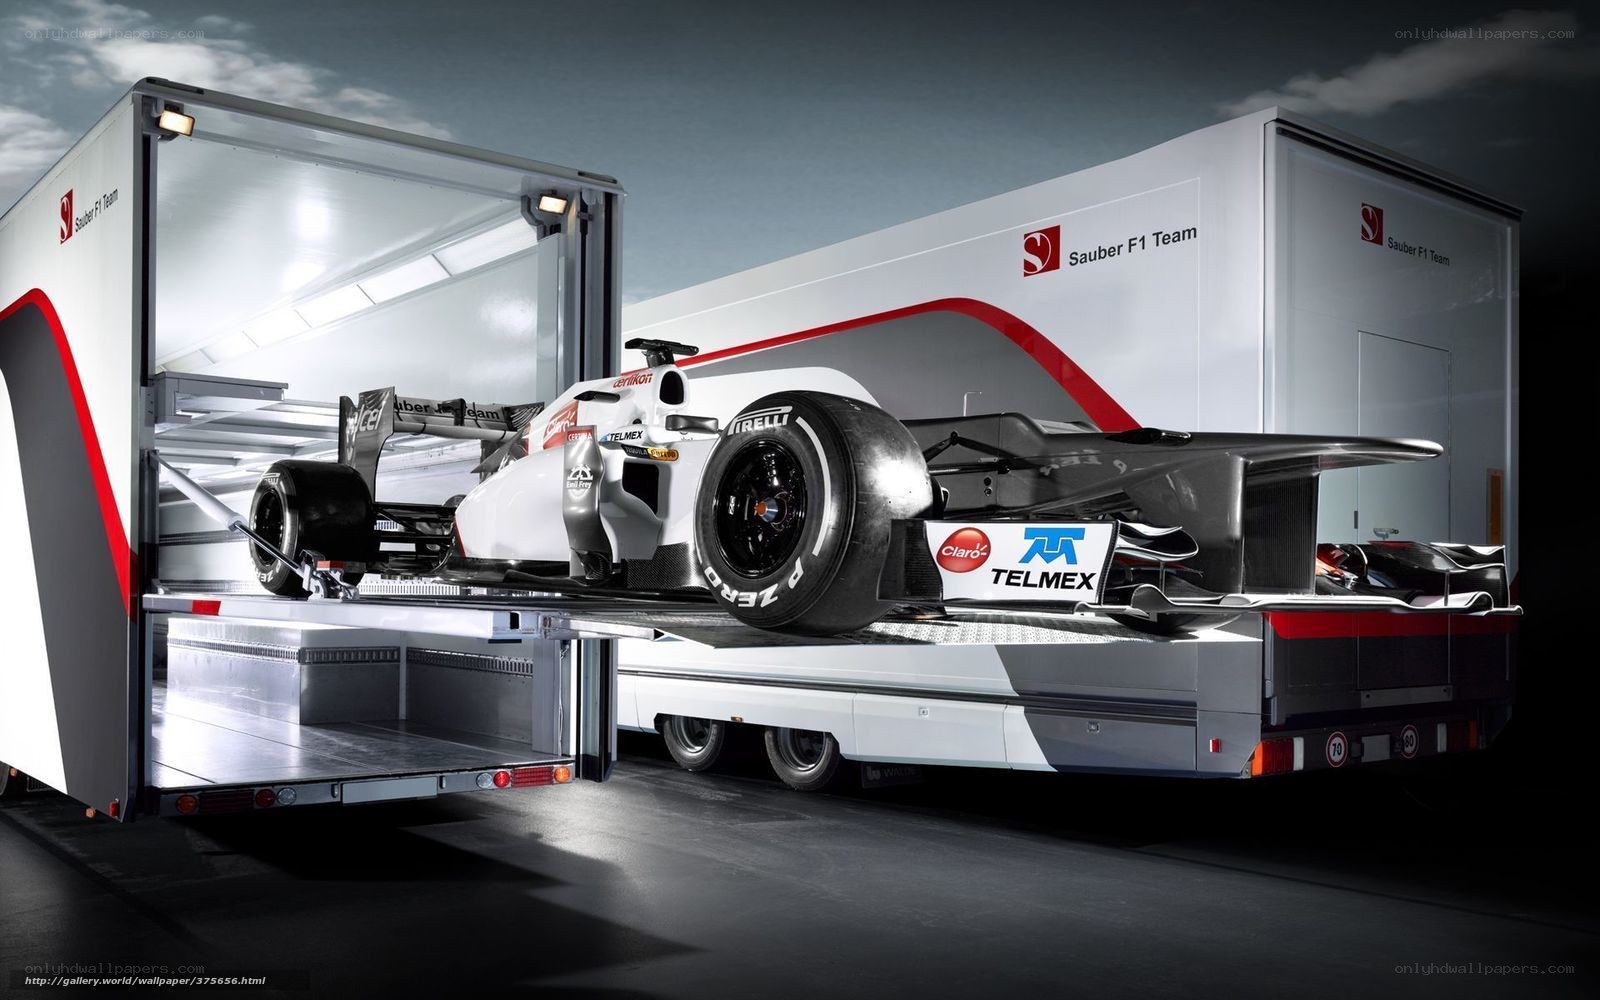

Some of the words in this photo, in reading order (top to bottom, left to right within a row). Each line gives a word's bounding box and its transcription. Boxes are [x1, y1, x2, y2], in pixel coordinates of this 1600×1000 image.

[75, 208, 94, 232] Sauber
[94, 198, 102, 217] F1
[103, 188, 119, 210] Team
[1069, 243, 1124, 267] Sauber
[1128, 235, 1146, 253] F1
[1152, 226, 1198, 248] Team
[1388, 236, 1417, 256] Sauber
[1418, 246, 1428, 259] F1
[1429, 249, 1450, 267] Team
[727, 405, 793, 436] PIRELLI
[568, 432, 593, 441] CERTA
[609, 430, 644, 442] TELMEX
[566, 480, 580, 488] Emil
[580, 480, 593, 490] Frey
[941, 544, 981, 560] Claro
[788, 557, 804, 589] P
[991, 568, 1097, 591] TELMEX
[704, 566, 779, 608] ZERO
[1332, 742, 1343, 757] 70
